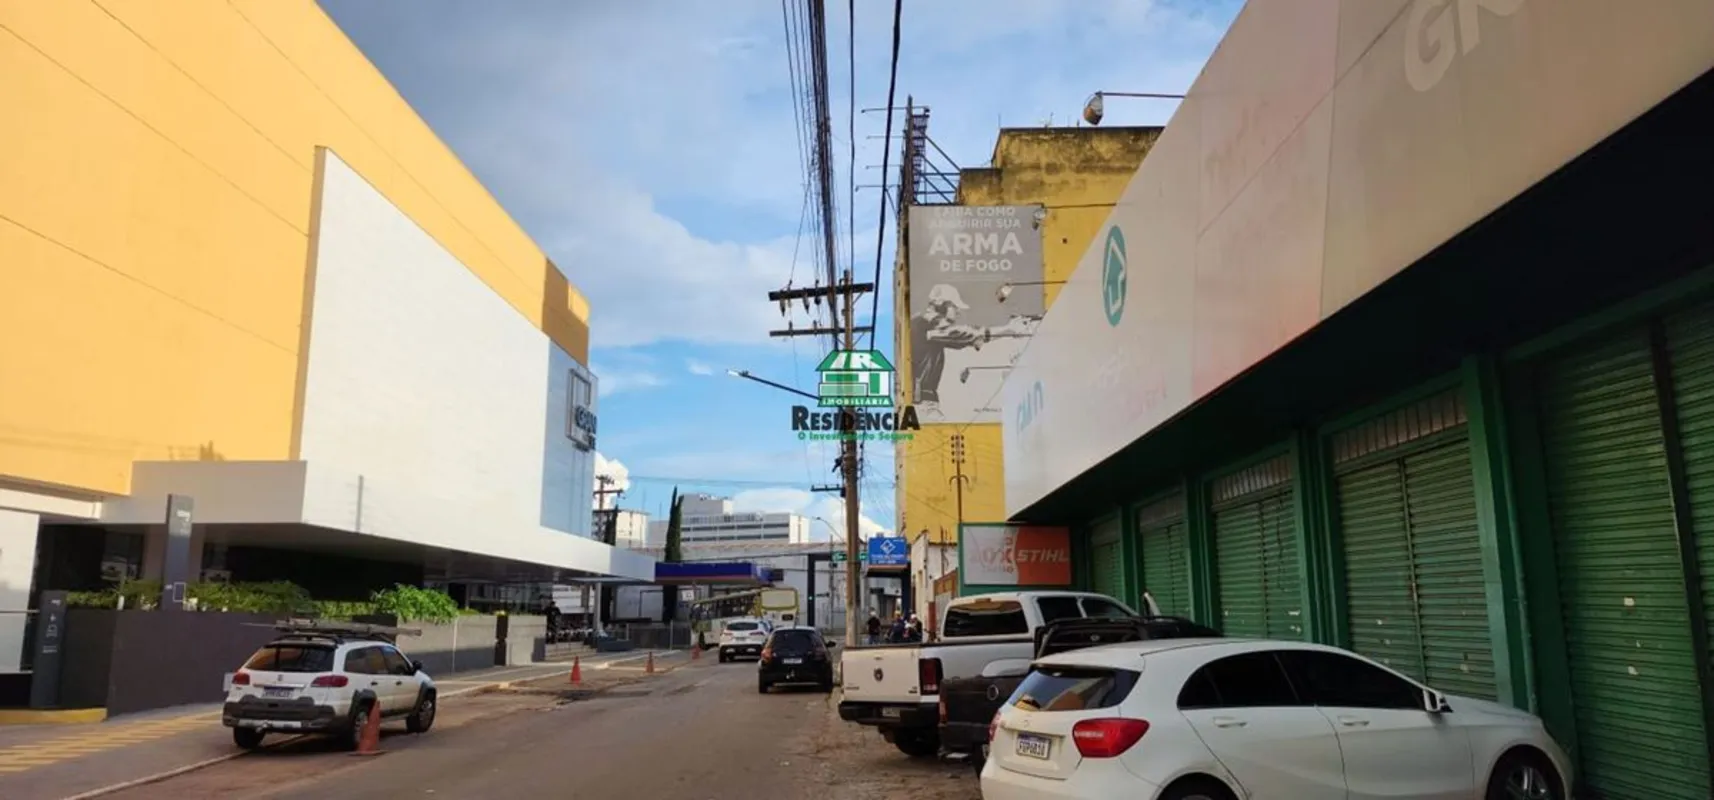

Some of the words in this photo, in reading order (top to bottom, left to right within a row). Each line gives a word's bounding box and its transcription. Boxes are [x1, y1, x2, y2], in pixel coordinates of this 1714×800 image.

[976, 206, 1016, 217] COMO
[996, 219, 1021, 229] SUA
[928, 231, 1023, 256] ARMA
[940, 260, 962, 272] DE
[965, 259, 1013, 272] FOGO
[1016, 548, 1070, 563] STIHL
